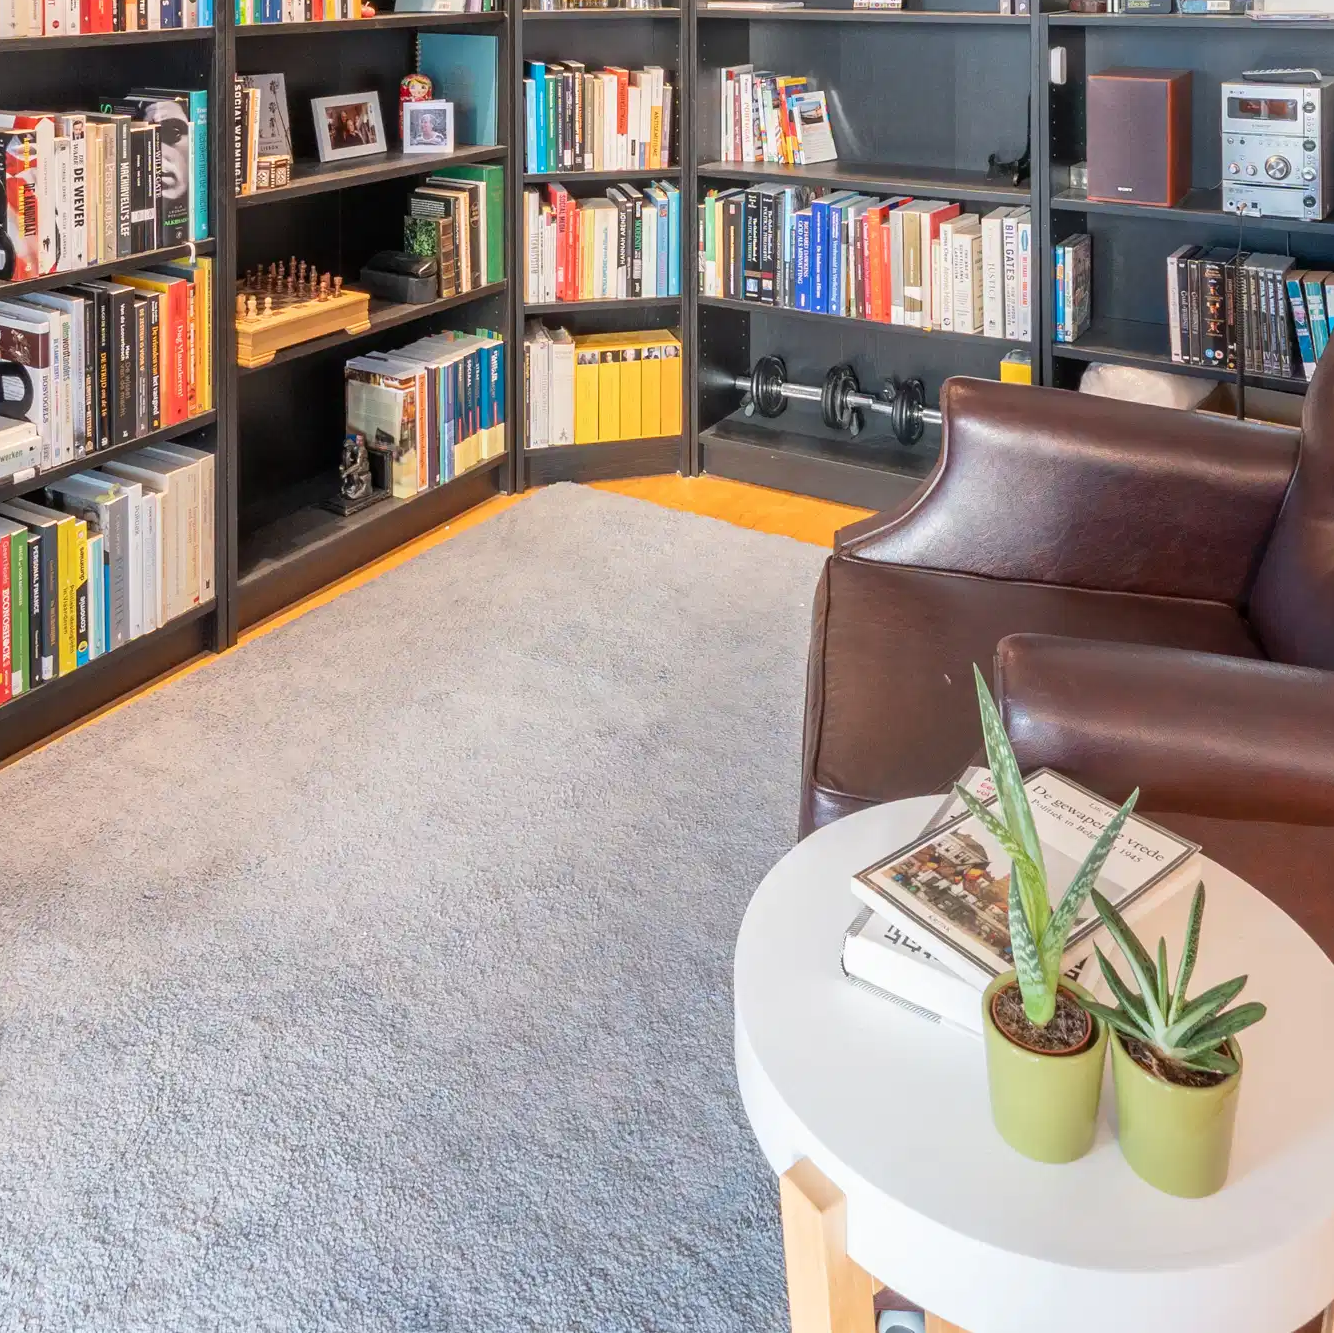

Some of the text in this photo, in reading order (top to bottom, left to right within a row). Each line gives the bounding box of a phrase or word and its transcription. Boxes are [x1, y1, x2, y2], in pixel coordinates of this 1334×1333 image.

[234, 84, 242, 177] SOCIAL WARMING
[24, 183, 36, 237] DE KANDIDAAT
[74, 167, 85, 228] DE WEVER
[104, 162, 115, 236] PERESTROJKA
[120, 162, 130, 237] MACHIAVELLI'S LEF
[1005, 224, 1014, 281] BILL GATES
[987, 263, 995, 302] JUSTICE
[100, 352, 107, 364] DE
[175, 324, 184, 398] Dag Vlaanderen!
[151, 387, 159, 415] vastgoed
[0, 449, 24, 463] werken
[32, 545, 40, 583] PERSONAL
[78, 595, 86, 634] Economie
[1031, 798, 1144, 864] Politiek in Belgi 1945
[1032, 785, 1165, 862] De gewapene vrede
